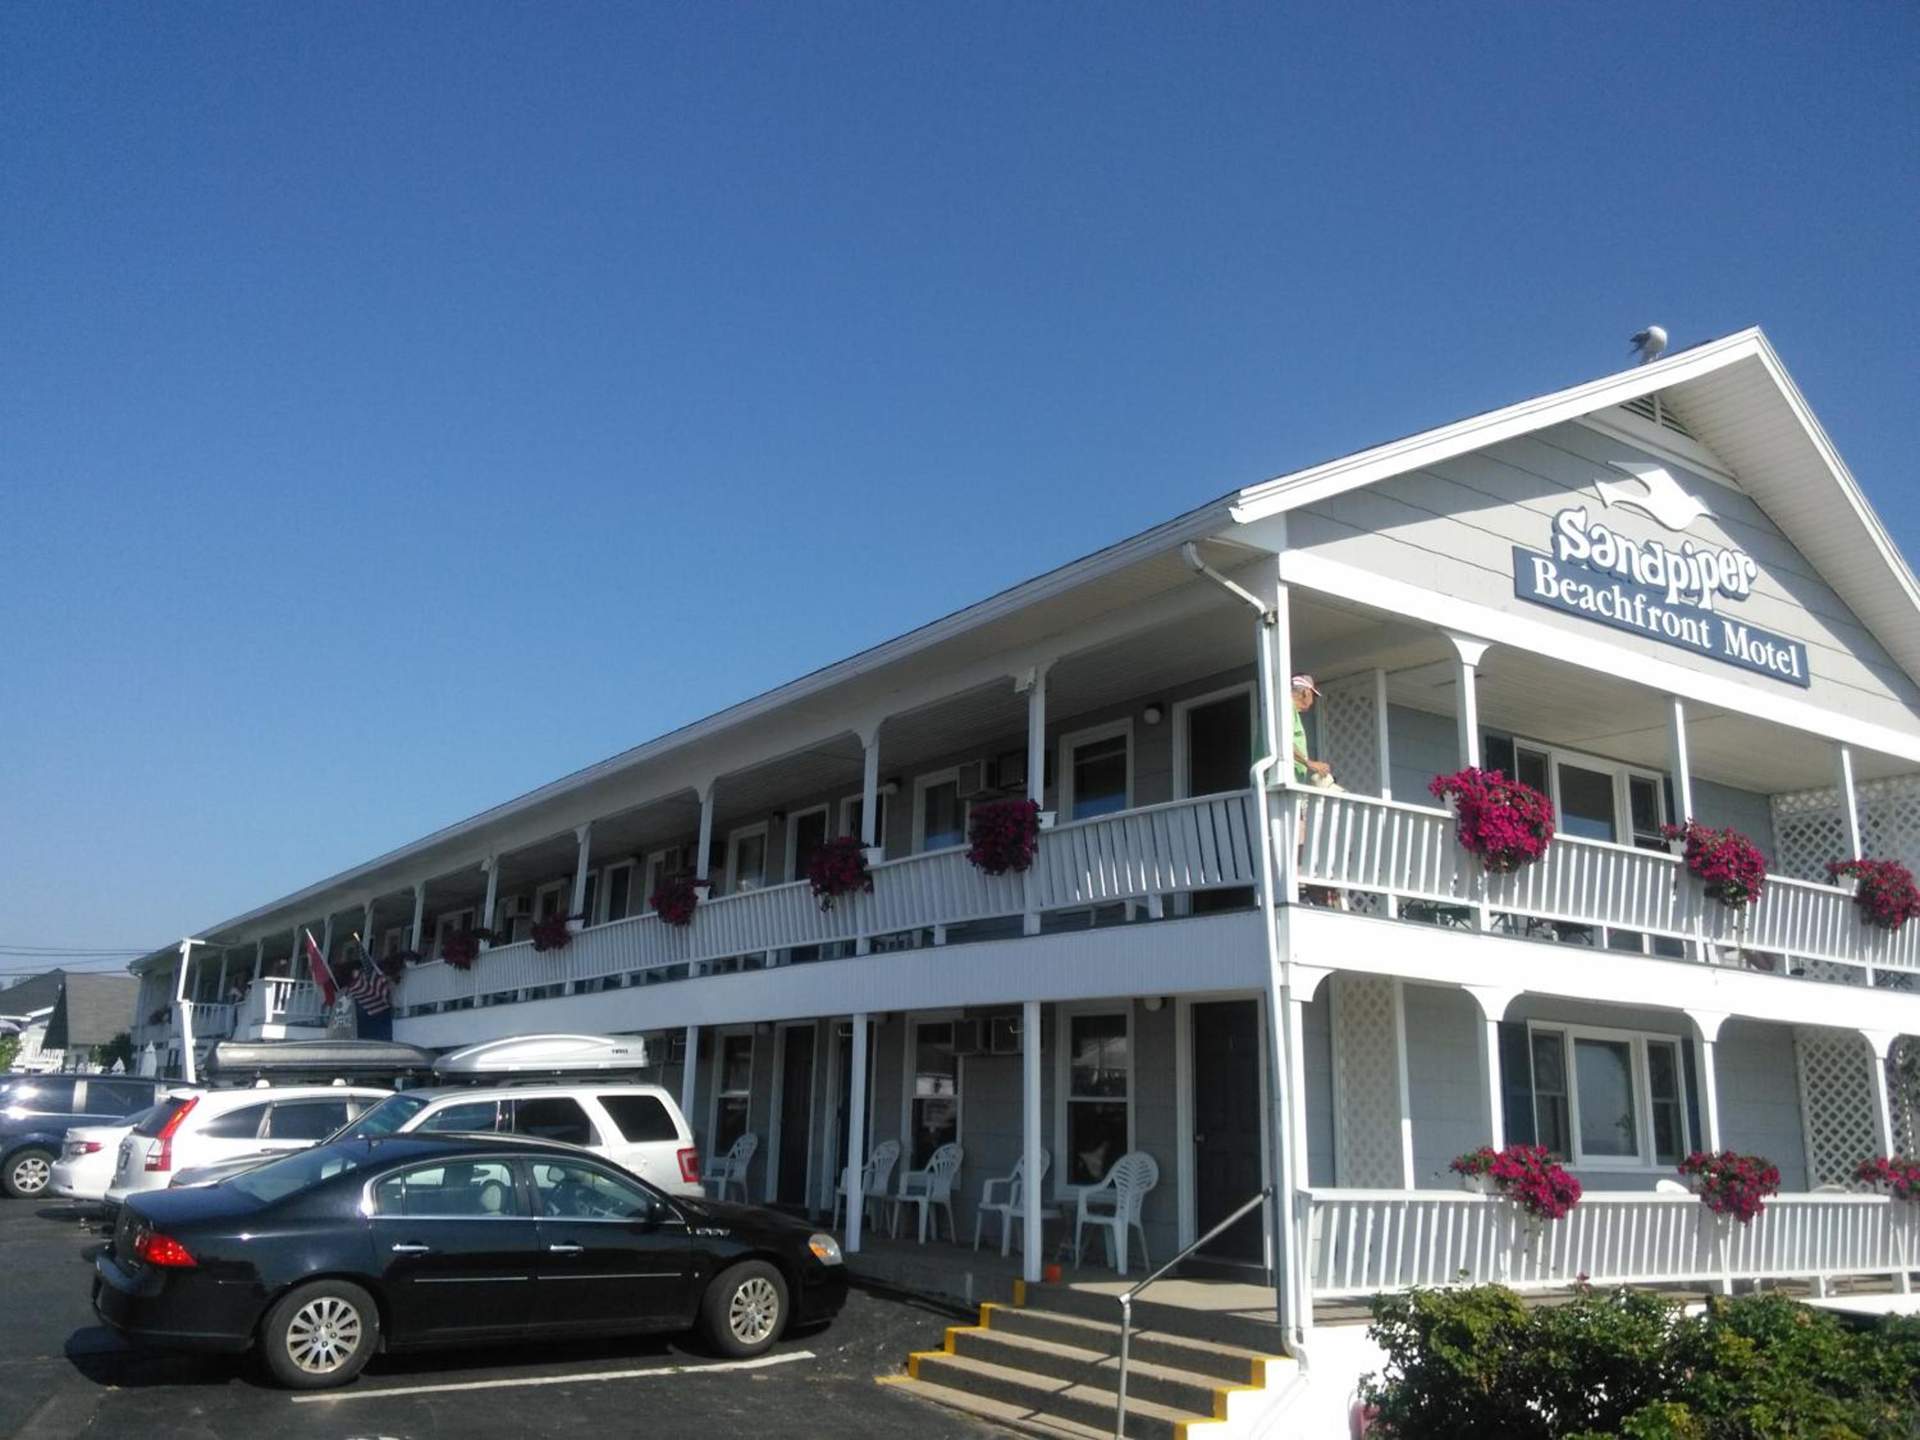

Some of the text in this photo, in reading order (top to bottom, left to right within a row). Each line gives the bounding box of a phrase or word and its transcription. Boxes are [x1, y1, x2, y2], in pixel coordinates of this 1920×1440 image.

[1555, 507, 1757, 610] Sandpiper
[1531, 557, 1801, 678] Beachfront Motel
